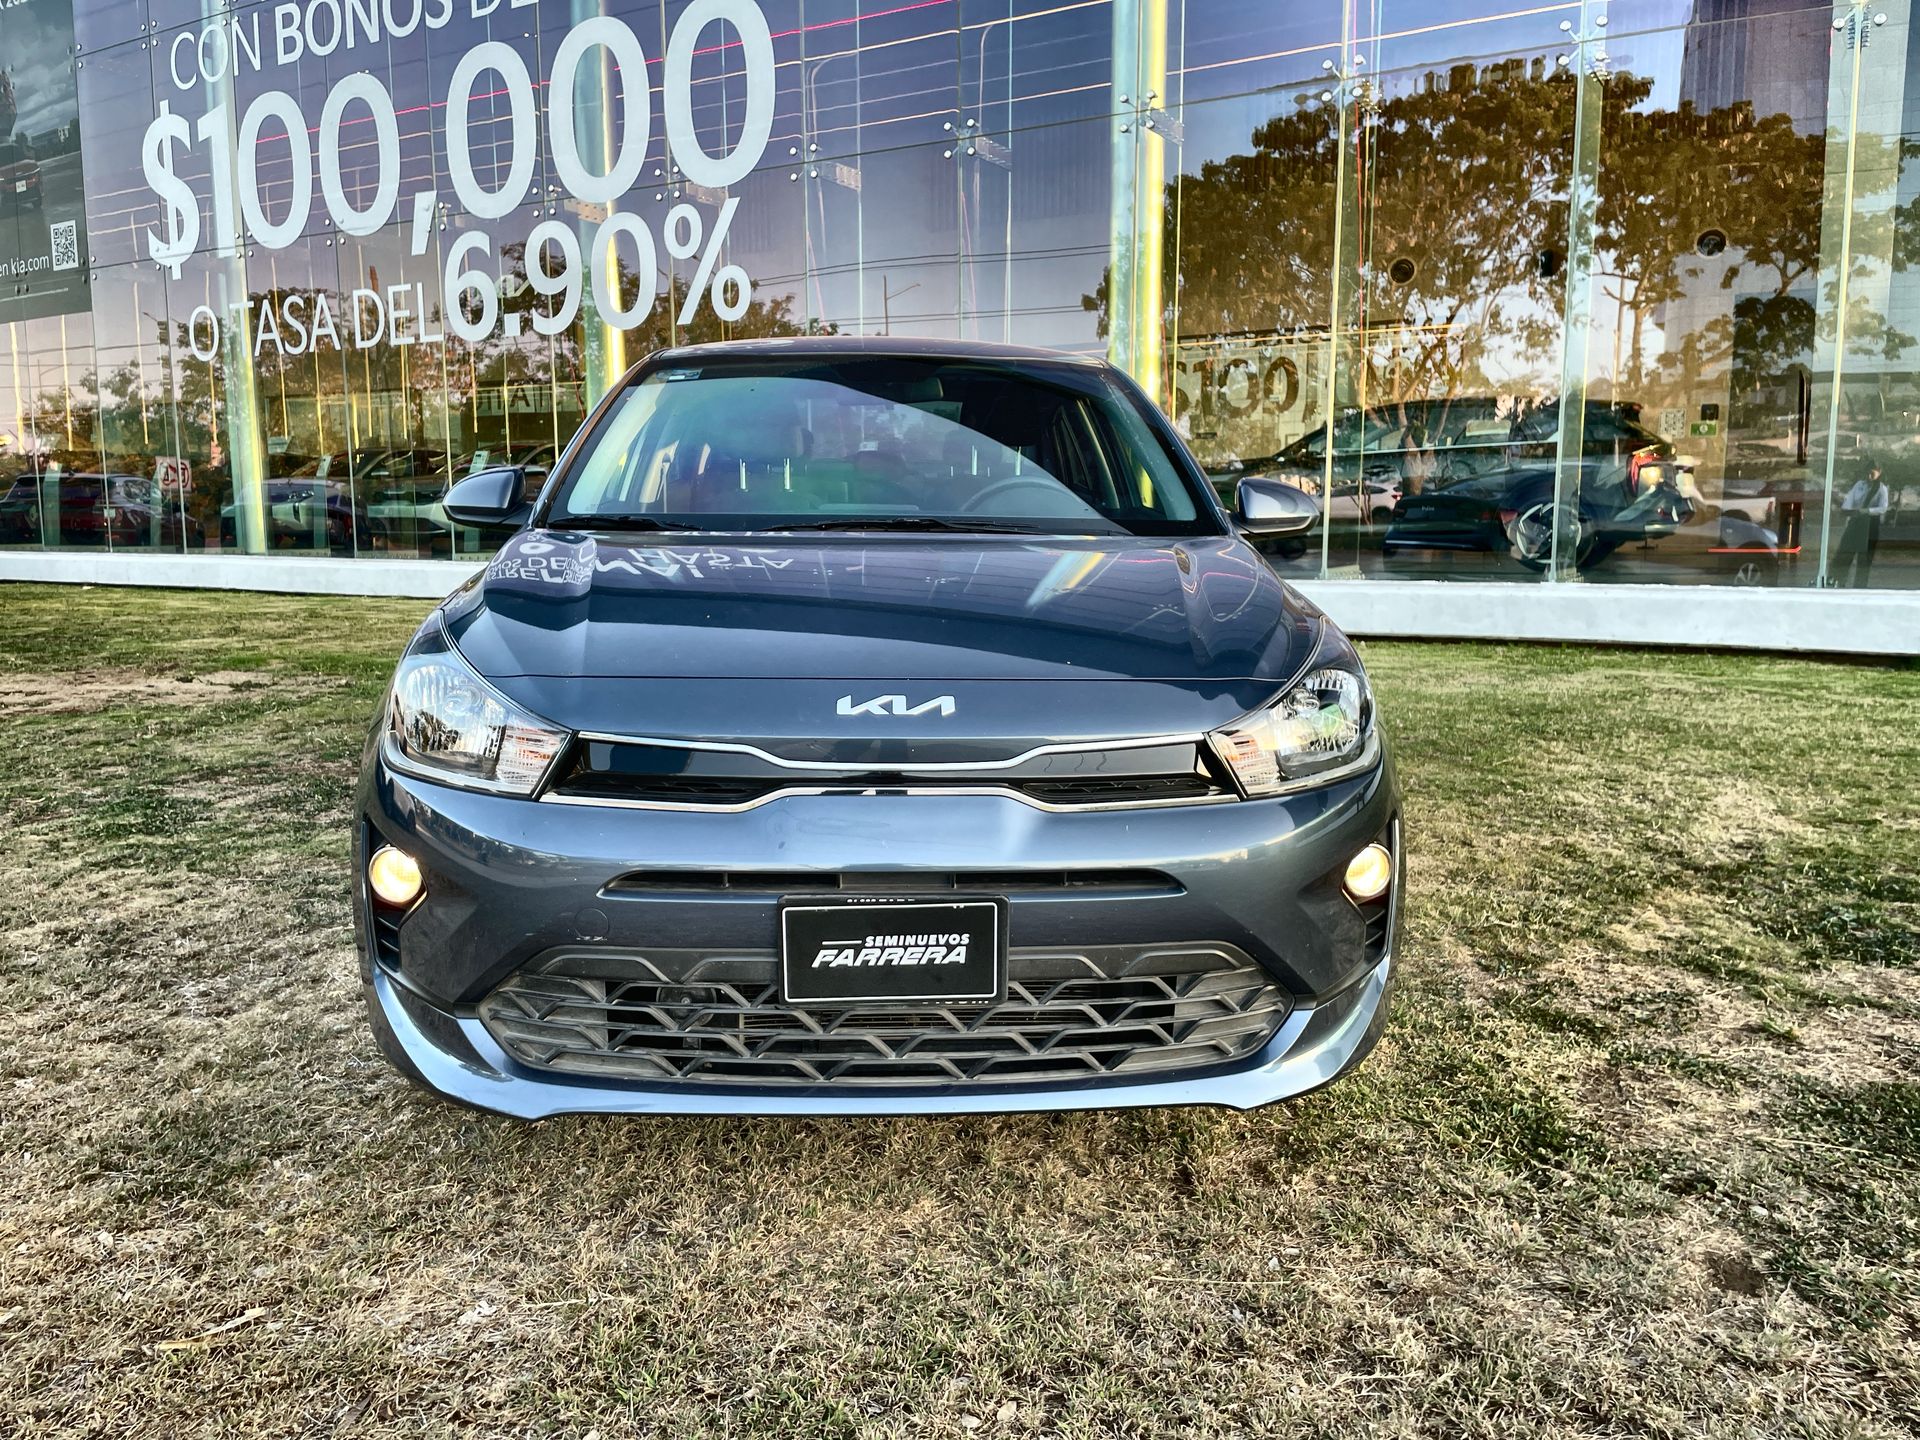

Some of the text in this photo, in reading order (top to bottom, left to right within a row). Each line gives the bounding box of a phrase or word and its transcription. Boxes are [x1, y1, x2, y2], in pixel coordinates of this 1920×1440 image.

[170, 14, 262, 90] CON
[142, 0, 775, 280] $100,000
[10, 255, 50, 275] kia.com
[189, 197, 752, 361] O TASA DEL 6.90%
[836, 694, 956, 716] KIA
[864, 933, 970, 947] SEMINUEVOS
[811, 946, 967, 968] FARRERA
